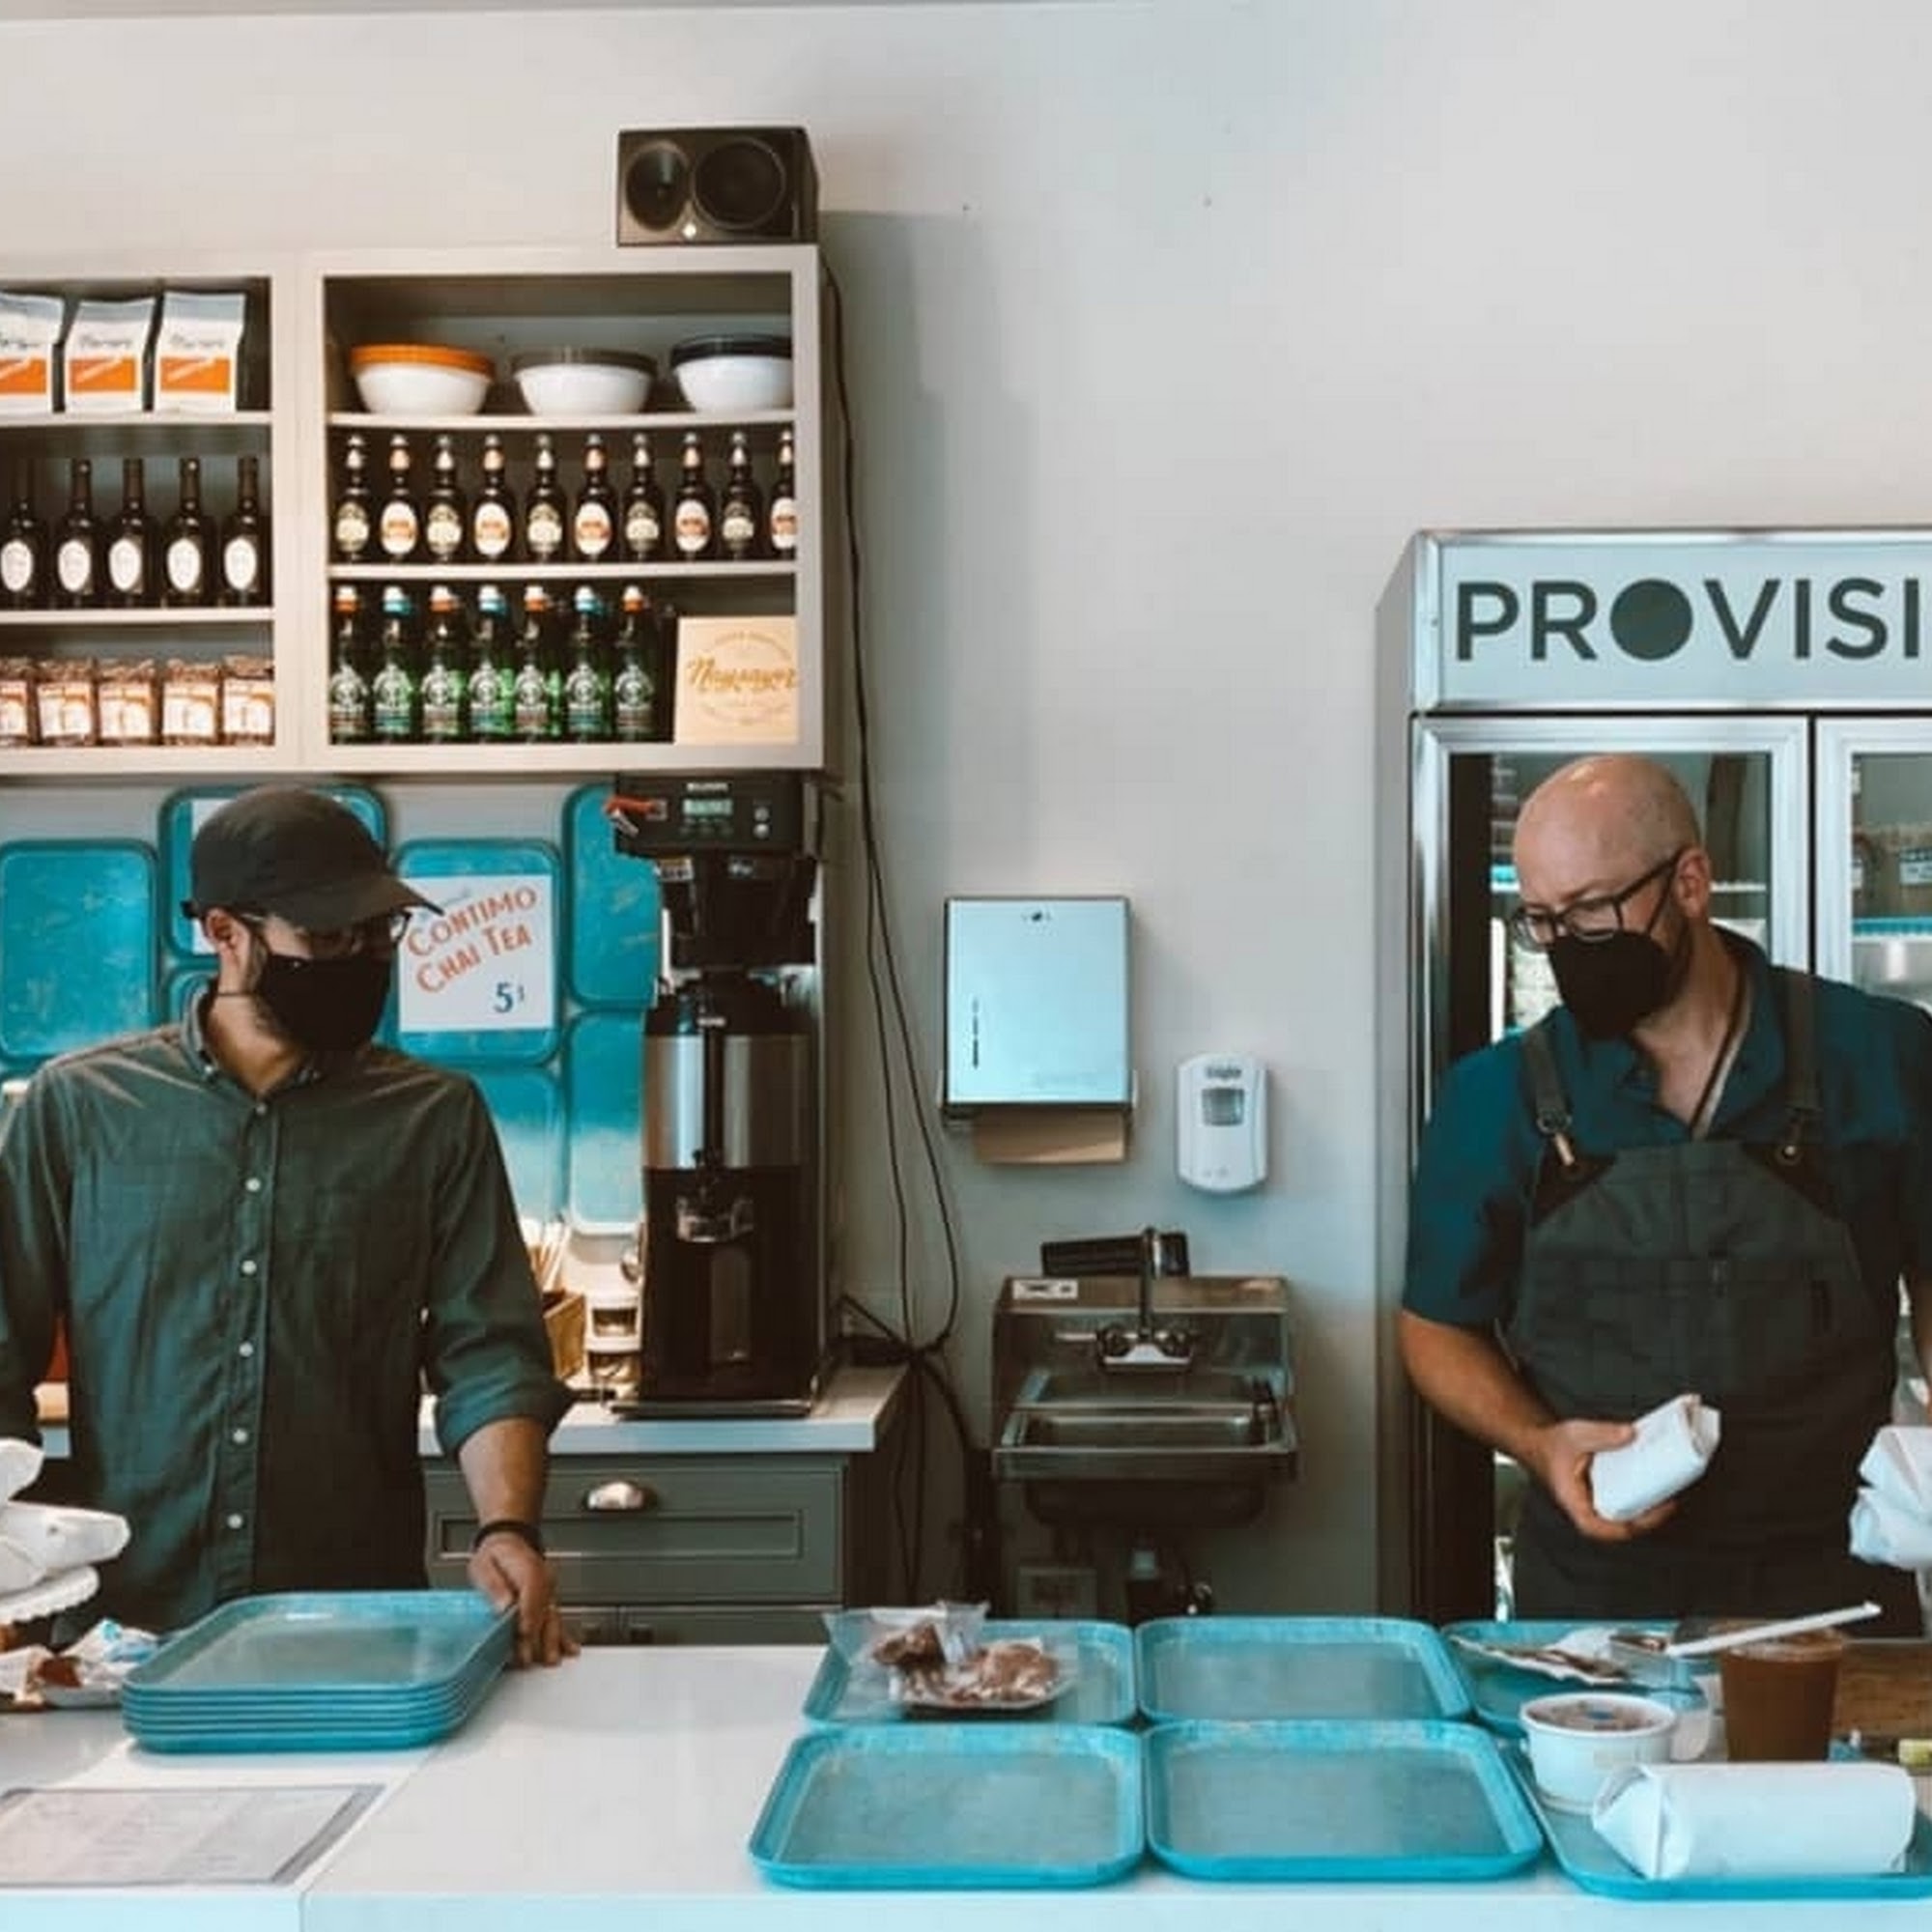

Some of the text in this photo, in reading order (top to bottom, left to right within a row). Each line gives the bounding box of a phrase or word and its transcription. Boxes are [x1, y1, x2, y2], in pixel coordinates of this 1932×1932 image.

[1456, 577, 1920, 662] PROVISI
[407, 886, 537, 956] CONTIMO
[416, 923, 533, 993] CHAI TEA
